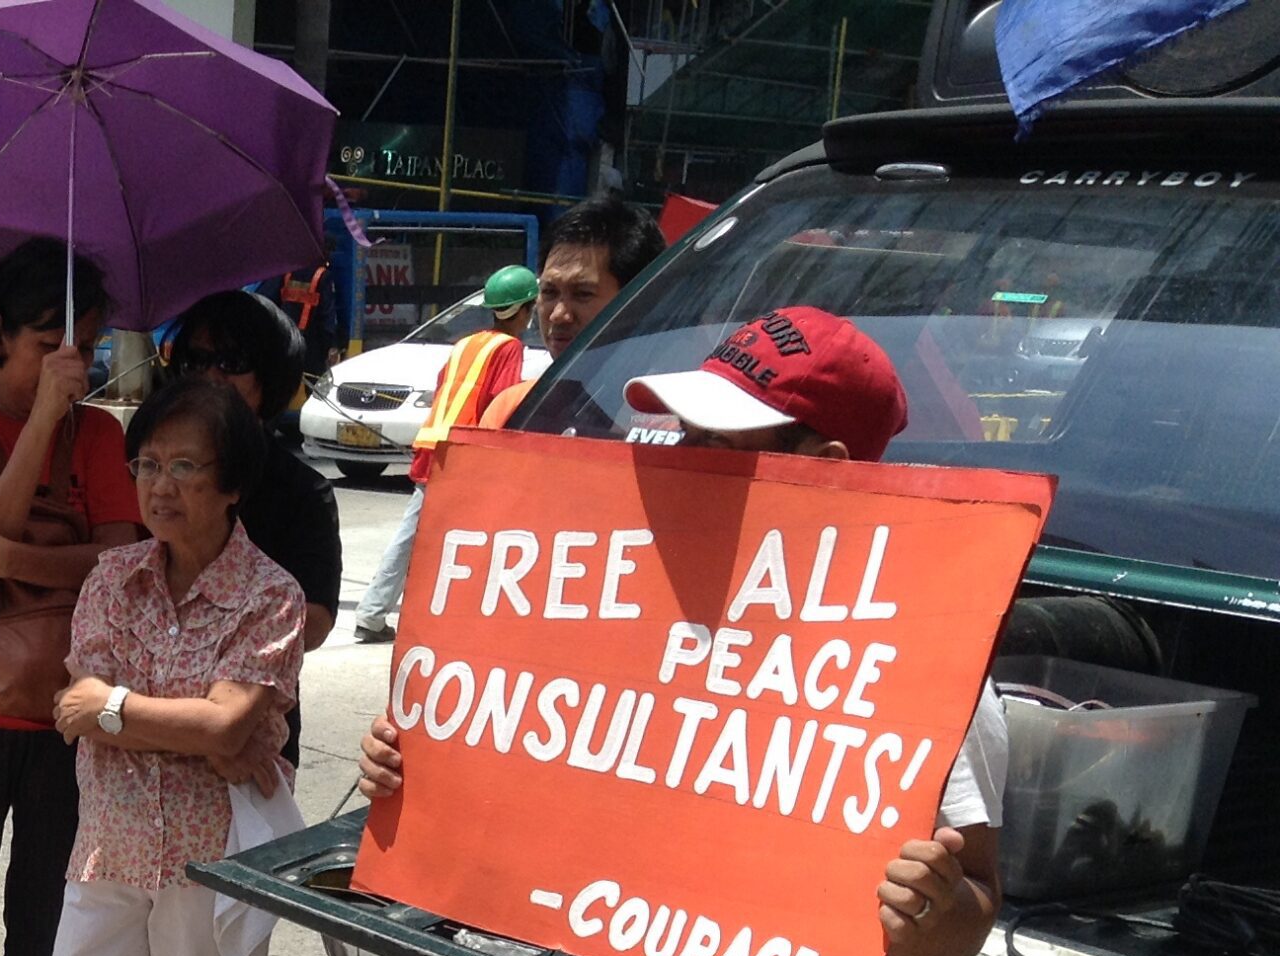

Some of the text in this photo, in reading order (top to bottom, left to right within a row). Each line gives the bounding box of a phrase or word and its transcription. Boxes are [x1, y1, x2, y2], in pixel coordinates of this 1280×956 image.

[452, 153, 505, 180] PLACE
[1019, 169, 1257, 188] CARRYBOY
[429, 524, 899, 623] FREE ALL
[658, 620, 900, 720] PEACE
[391, 644, 934, 837] CONSULTANTS!
